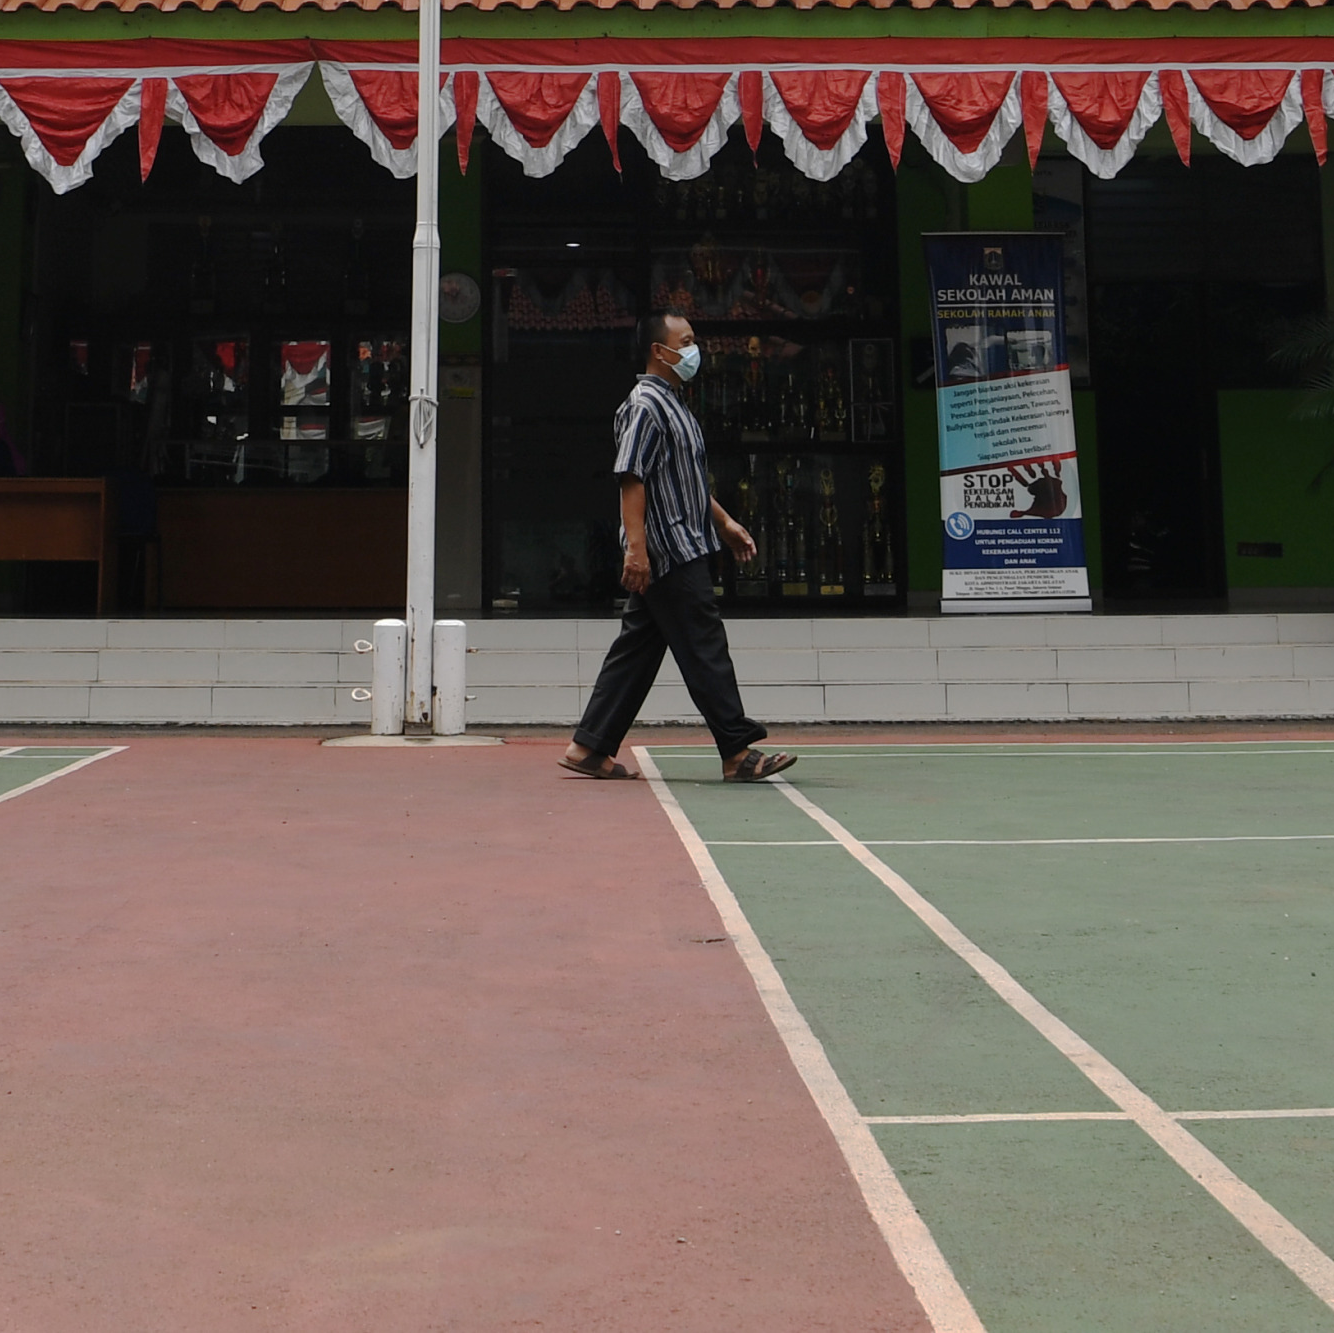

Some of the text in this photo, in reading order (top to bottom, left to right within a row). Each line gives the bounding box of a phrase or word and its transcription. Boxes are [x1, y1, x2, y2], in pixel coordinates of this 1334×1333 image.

[969, 273, 1022, 286] KAWAL
[937, 288, 1054, 302] SEKOLAH AMAN
[937, 309, 1056, 319] SEKOLAH RAMAH ANAK
[953, 388, 977, 398] Jangan
[1004, 382, 1016, 390] aksi
[1018, 377, 1050, 387] kekerasan
[1022, 388, 1058, 399] Pelecehan,
[1031, 398, 1061, 409] Tawuran,
[946, 422, 974, 432] Bullying
[988, 416, 1010, 426] Tindak
[1011, 411, 1045, 421] Kekerasan
[996, 427, 1009, 435] dan
[1010, 422, 1047, 433] mencemari
[992, 437, 1017, 447] sekolah
[977, 450, 1009, 461] Siapapun
[1009, 448, 1024, 456] bisa
[963, 473, 1013, 488] STOP
